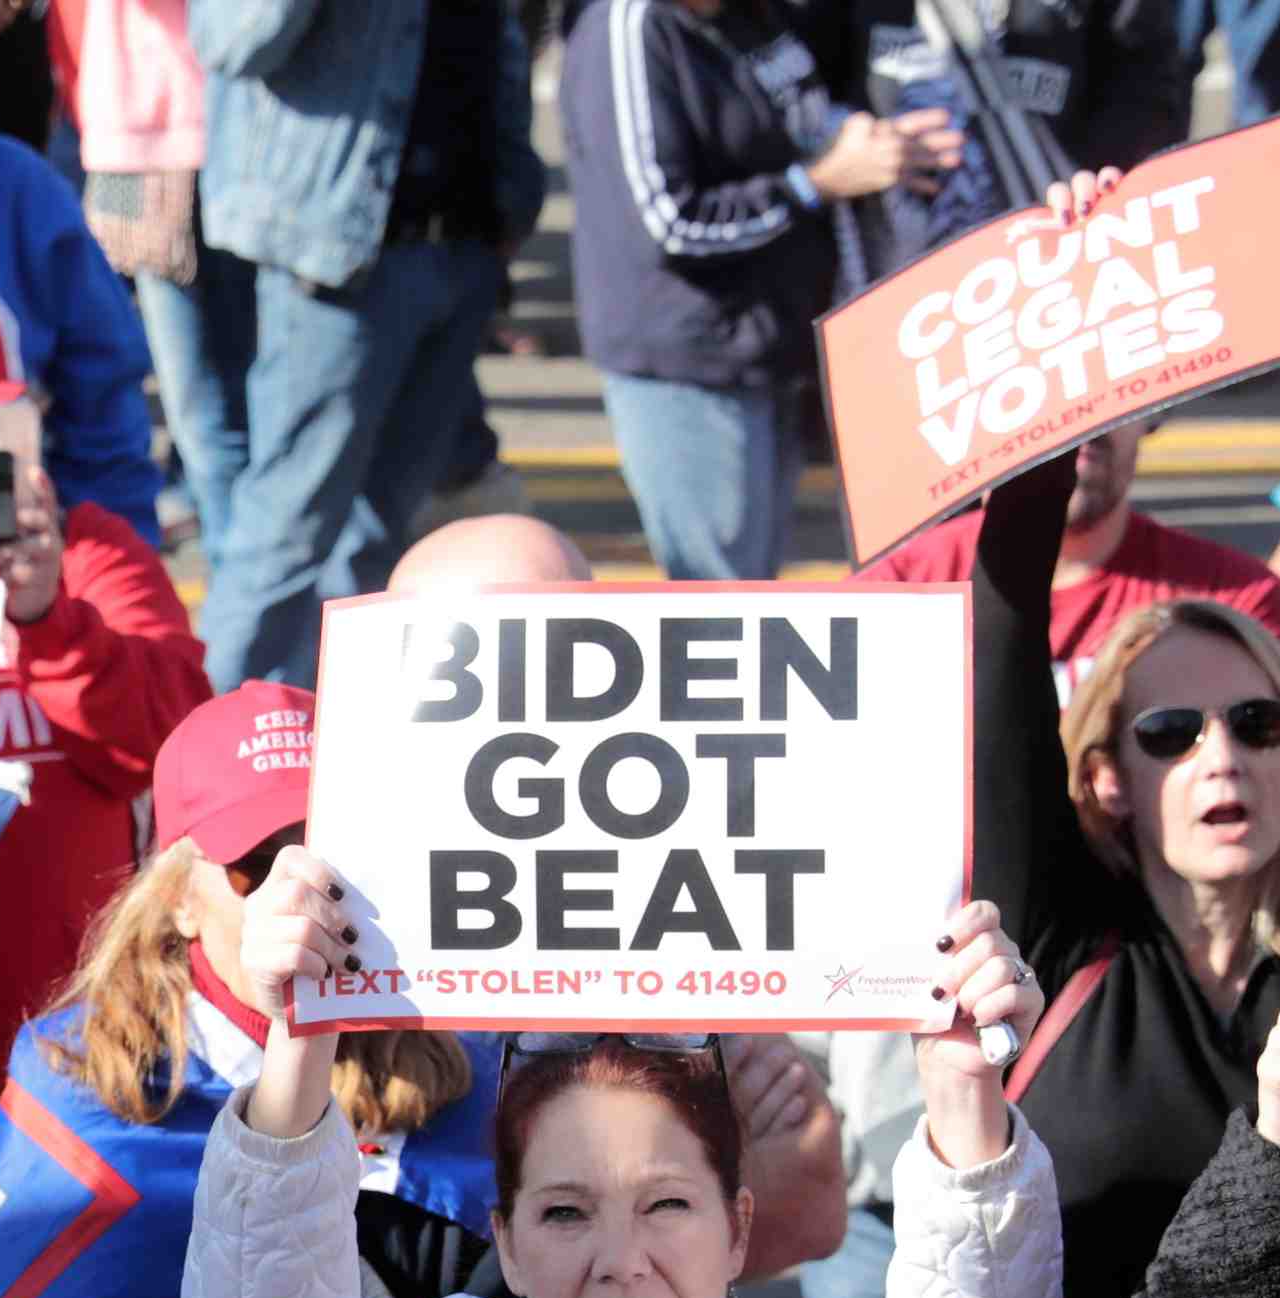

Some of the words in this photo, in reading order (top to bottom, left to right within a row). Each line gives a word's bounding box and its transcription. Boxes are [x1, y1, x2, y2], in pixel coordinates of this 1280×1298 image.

[897, 175, 1215, 359] COUNT
[916, 240, 1215, 418] LEGAL
[918, 289, 1224, 466] VOTES
[927, 457, 983, 502] TEXT
[1113, 376, 1149, 401] TO
[1155, 346, 1234, 388] 41490
[254, 709, 309, 732] KEEP
[401, 617, 859, 723] BIDEN
[237, 731, 315, 760] AMERIC
[251, 751, 312, 774] GREA
[463, 731, 786, 841] GOT
[429, 849, 826, 953] BEAT
[317, 969, 405, 997] TEXT
[613, 969, 665, 997] TO
[675, 969, 787, 997] 41490
